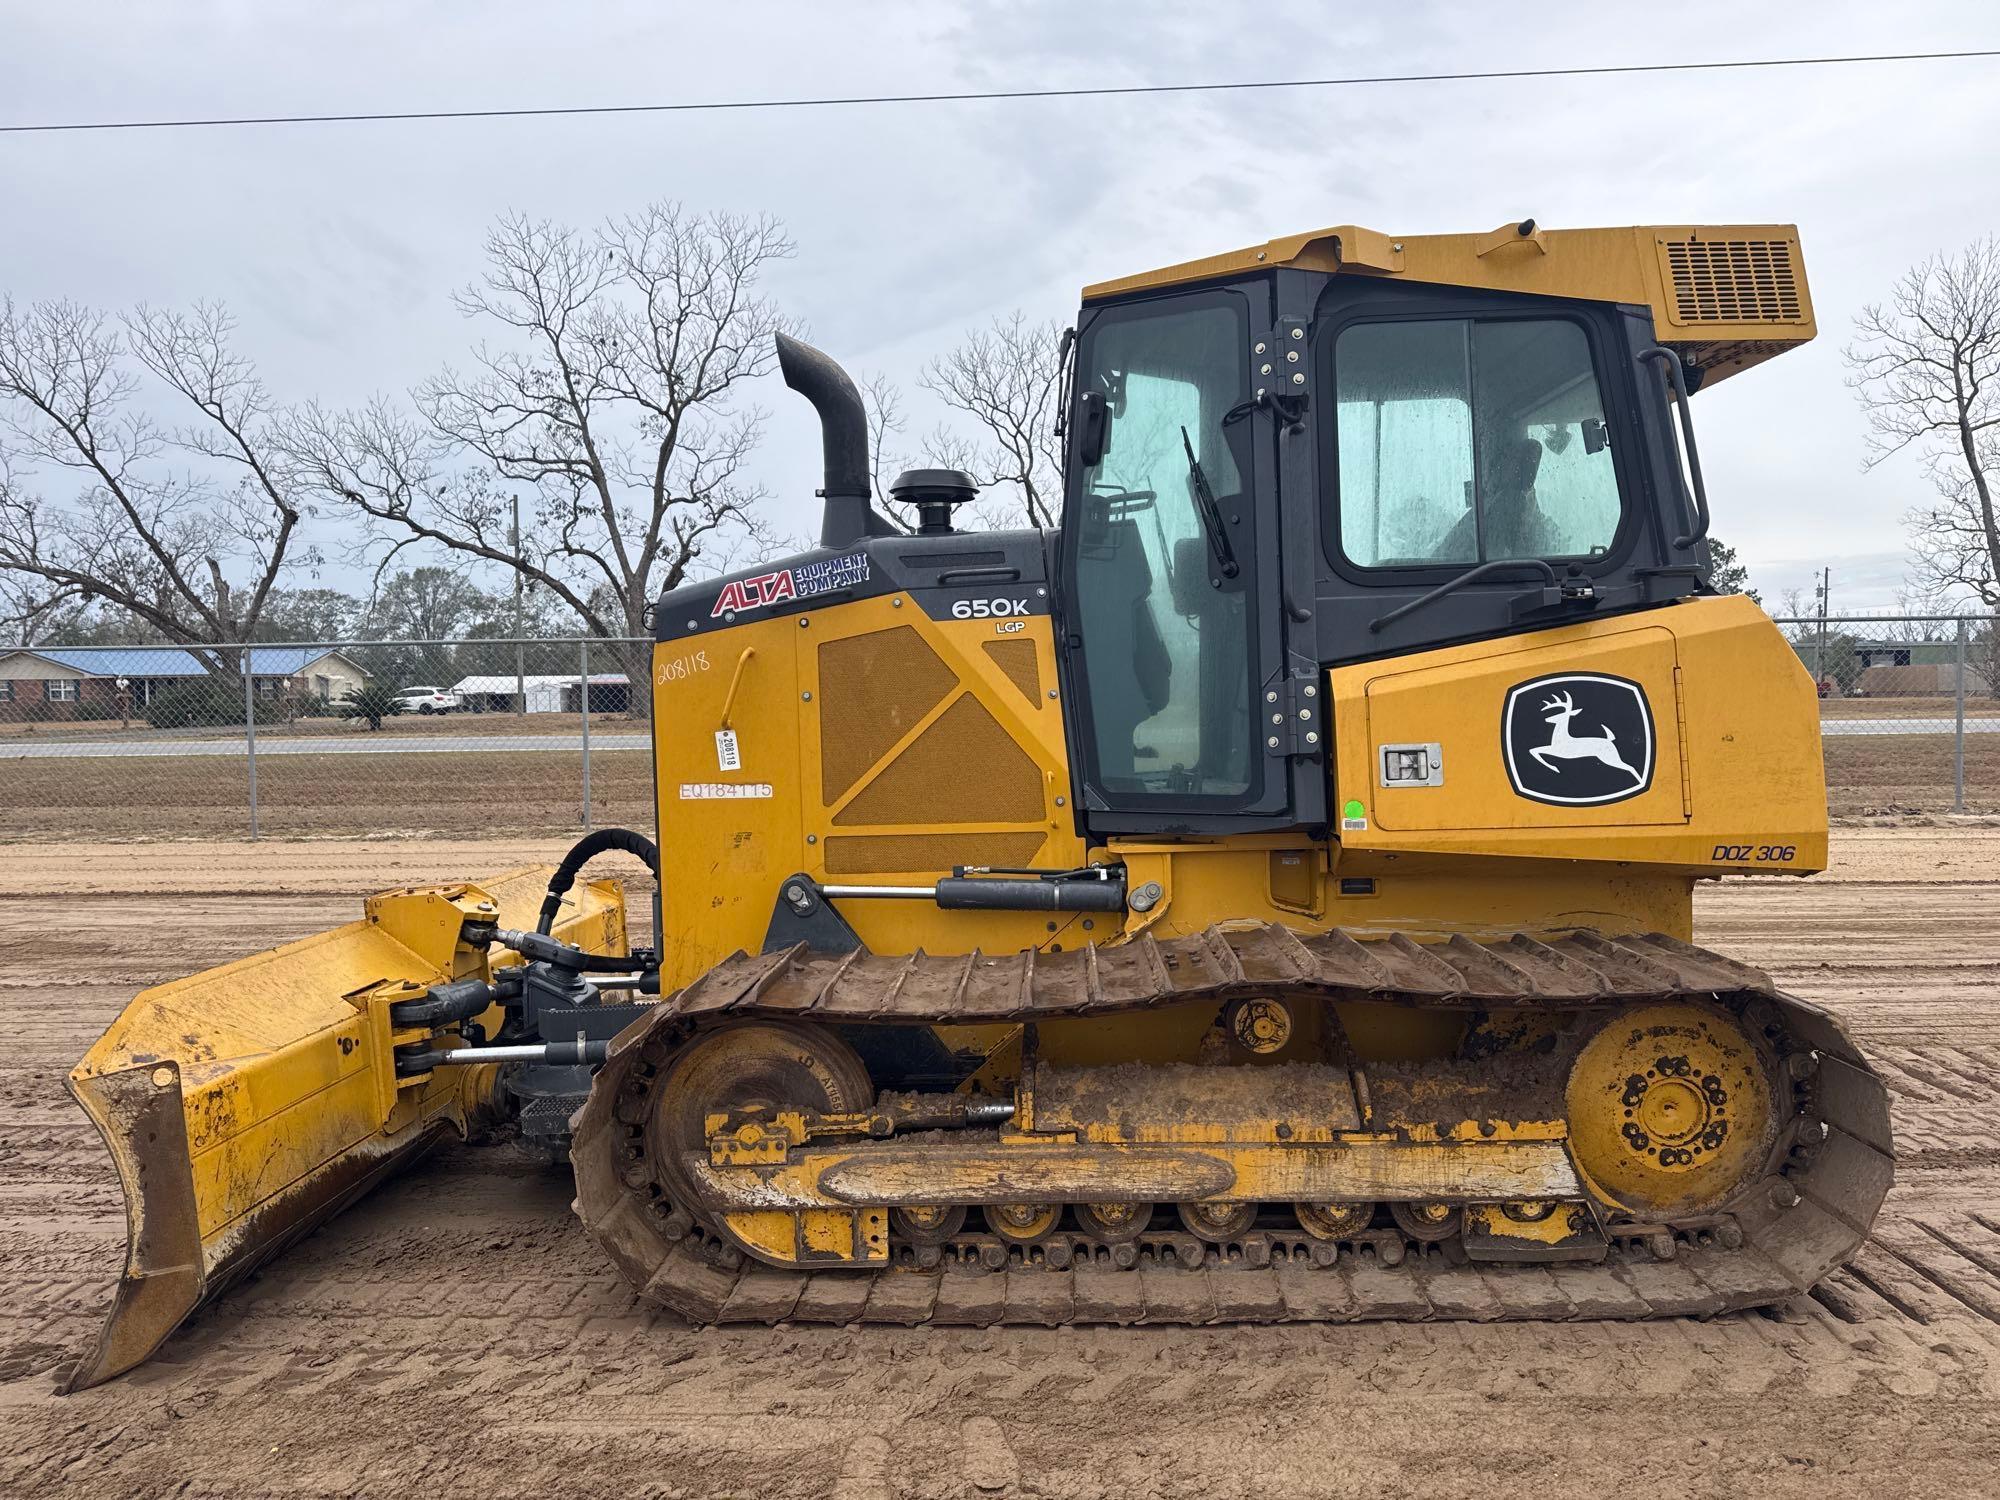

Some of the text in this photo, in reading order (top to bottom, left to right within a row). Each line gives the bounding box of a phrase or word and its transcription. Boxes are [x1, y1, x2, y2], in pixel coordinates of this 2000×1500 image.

[710, 552, 868, 618] ALTA EQUIPMENT
[796, 567, 870, 596] COMPANY
[952, 598, 1030, 619] 650K
[996, 622, 1025, 634] LGP
[657, 650, 710, 685] 208118
[723, 738, 737, 766] 208118
[681, 784, 771, 798] EQ184115
[1712, 846, 1796, 861] DOZ 306
